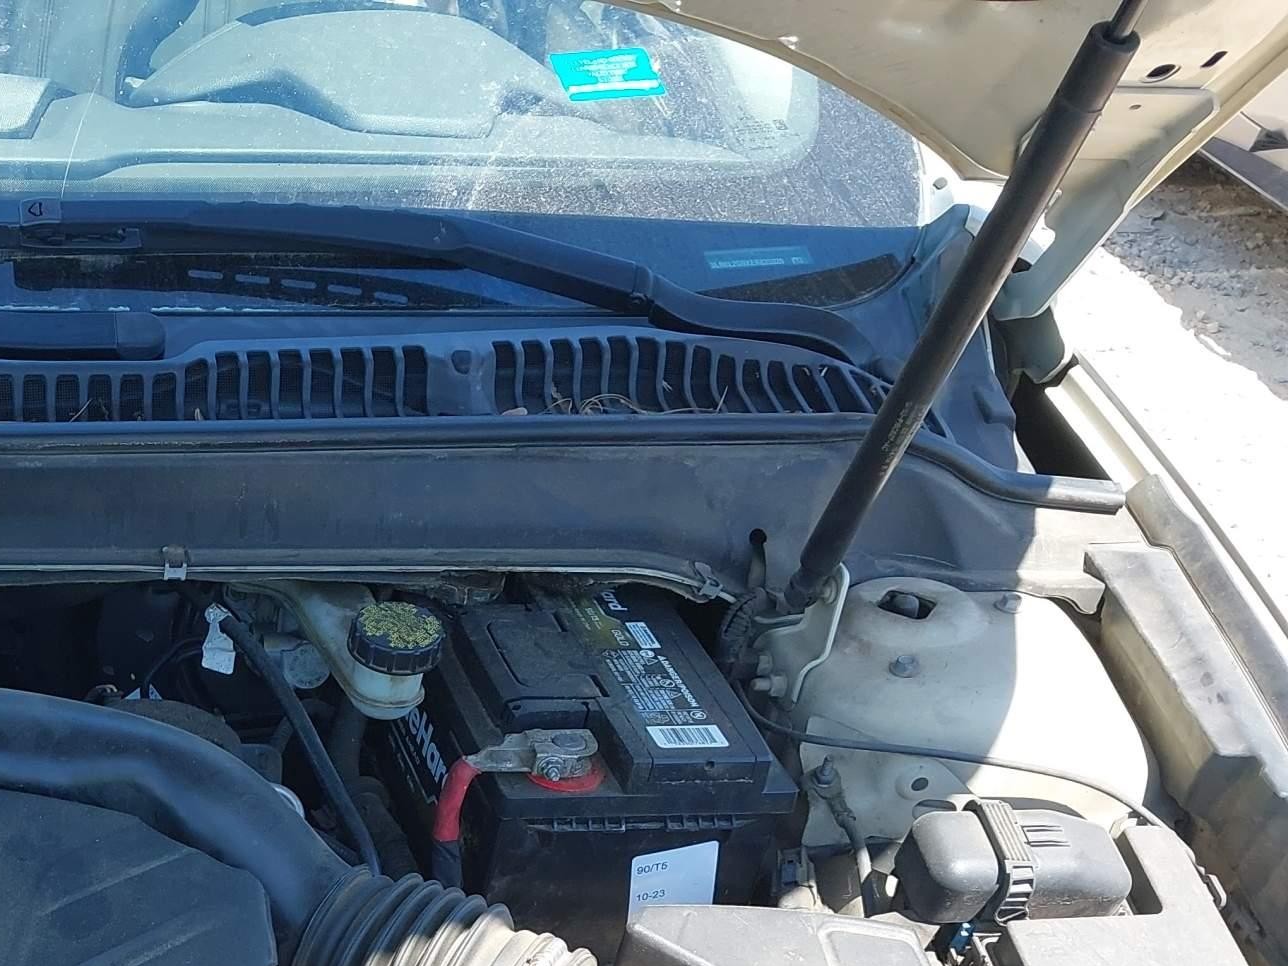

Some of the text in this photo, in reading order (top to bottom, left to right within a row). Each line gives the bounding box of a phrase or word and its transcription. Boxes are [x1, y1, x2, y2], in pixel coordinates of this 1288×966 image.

[601, 589, 628, 611] ard
[407, 706, 449, 787] eHar
[636, 889, 666, 902] 10-23
